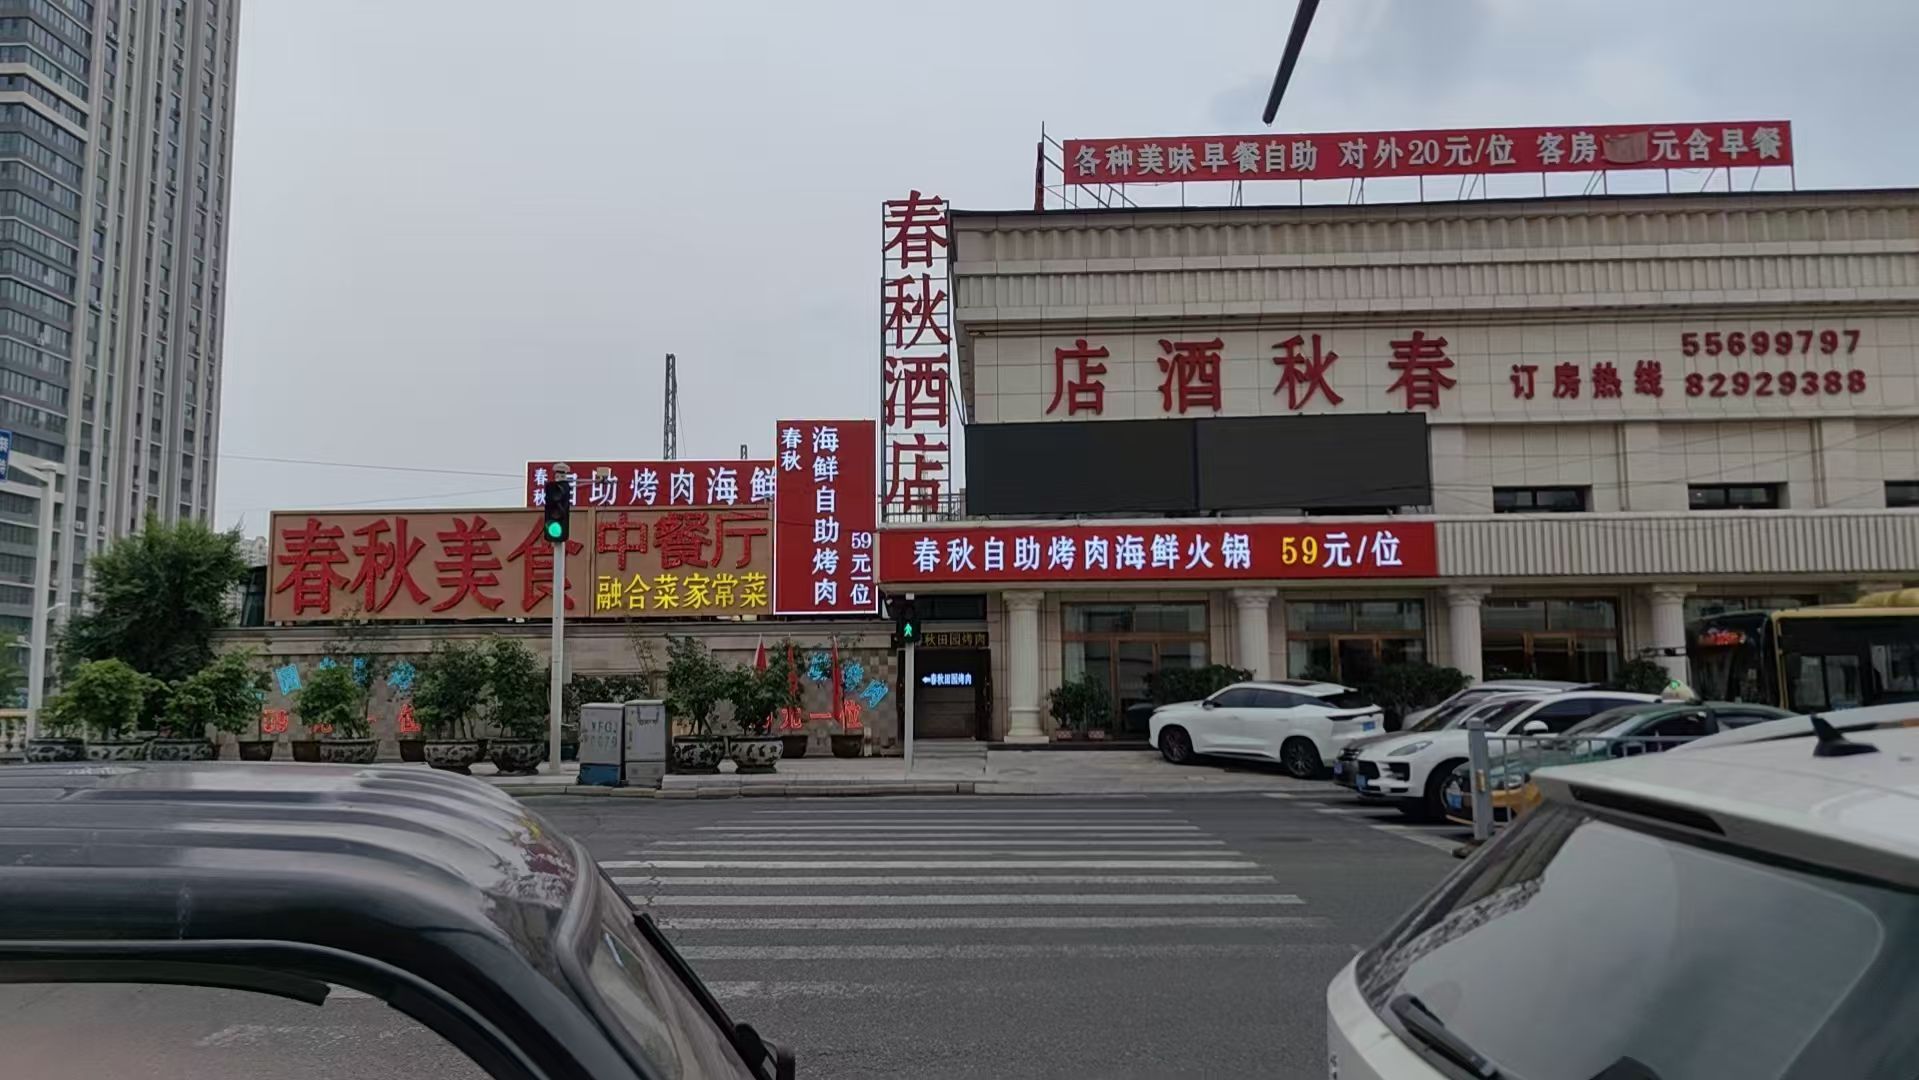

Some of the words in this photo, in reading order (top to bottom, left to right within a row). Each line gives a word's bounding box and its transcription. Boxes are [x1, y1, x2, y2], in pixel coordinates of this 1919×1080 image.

[1073, 139, 1318, 177] 各种美味早餐自助
[1338, 134, 1517, 170] 对外20元/位
[1536, 131, 1598, 165] 客房
[1652, 126, 1784, 161] 元含早餐
[883, 189, 952, 513] 春秋酒店
[1681, 329, 1861, 357] 55699797
[1510, 359, 1664, 400] 订房热线
[1684, 370, 1867, 397] 82929388
[781, 427, 802, 472] 春秋
[812, 426, 840, 606] 海鲜自助烤肉
[597, 511, 768, 571] 中餐厅
[912, 533, 1252, 574] 春秋自助烤肉海鲜火锅
[1281, 530, 1404, 567] 59元/位
[275, 516, 584, 616] 春秋美食
[596, 572, 768, 610] 融合菜家常菜
